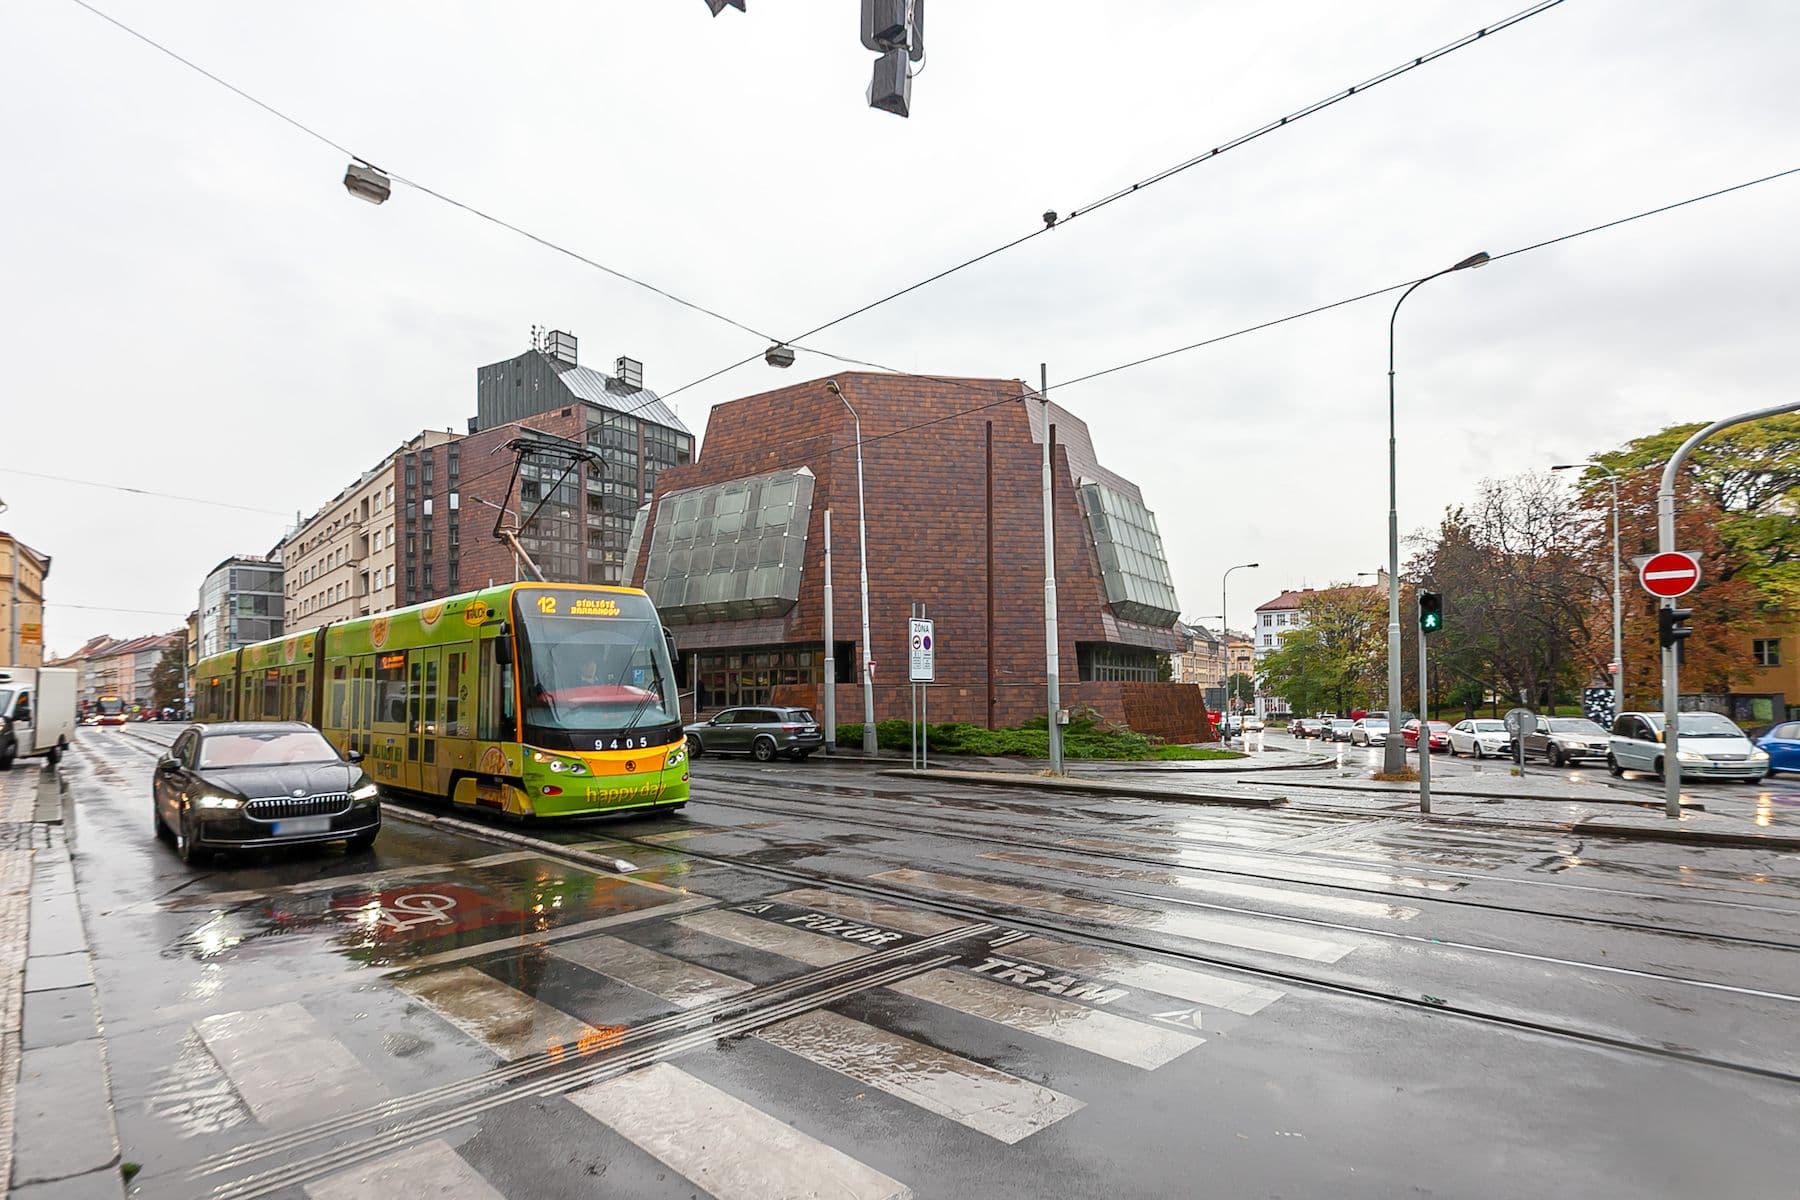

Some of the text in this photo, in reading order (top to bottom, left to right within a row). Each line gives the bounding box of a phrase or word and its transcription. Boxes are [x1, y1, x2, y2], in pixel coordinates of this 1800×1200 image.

[537, 596, 556, 614] 12
[594, 737, 648, 751] 9405
[586, 781, 667, 804] happy day
[784, 913, 903, 946] POZOR
[969, 956, 1130, 1005] TRAM
